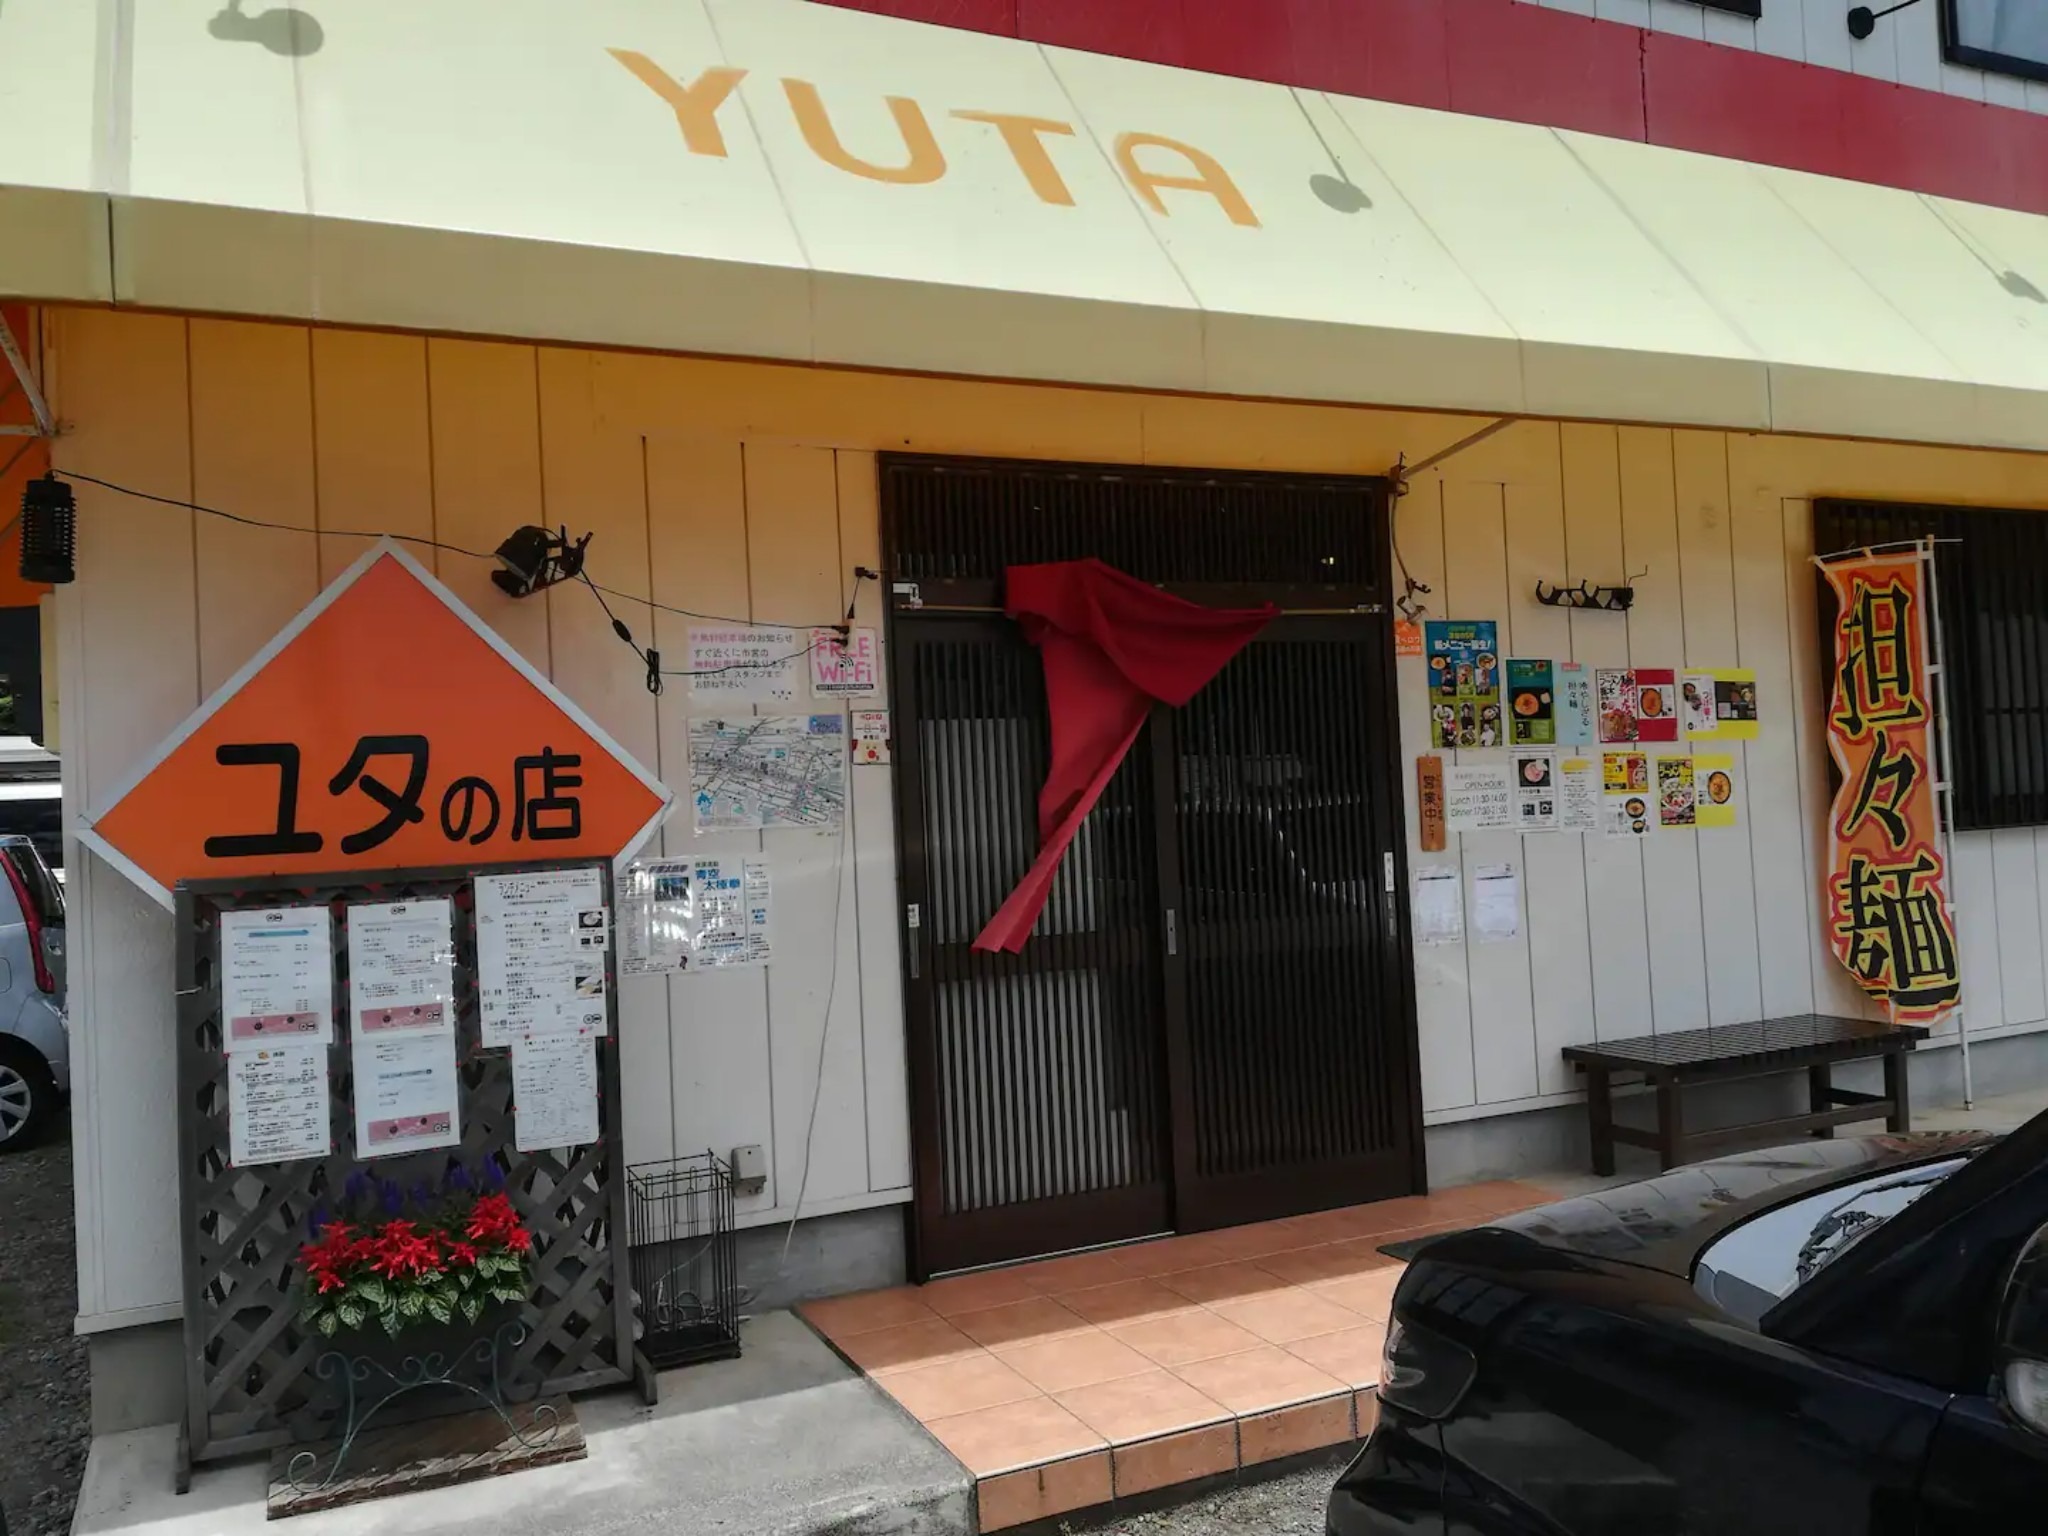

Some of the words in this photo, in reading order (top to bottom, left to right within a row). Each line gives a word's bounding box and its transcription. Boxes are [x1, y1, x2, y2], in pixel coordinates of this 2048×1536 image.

[604, 47, 1262, 230] YUTA
[817, 661, 872, 683] Wi-Fi
[204, 735, 583, 858] ユタの店
[1450, 796, 1471, 805] Lunch
